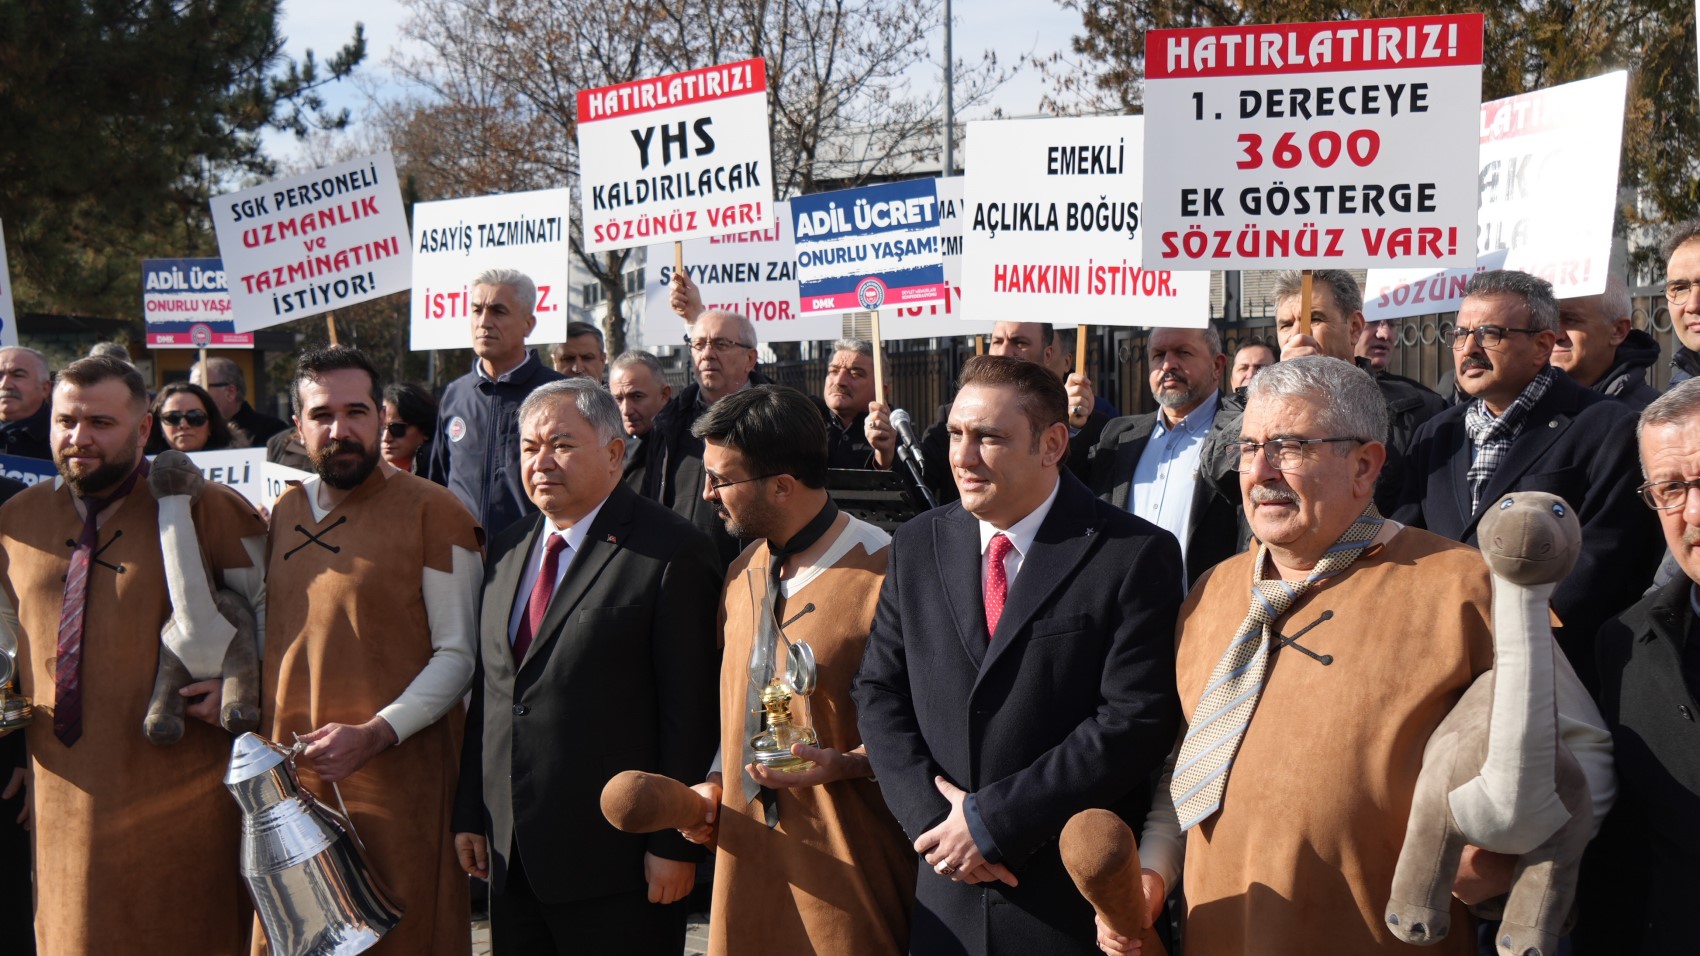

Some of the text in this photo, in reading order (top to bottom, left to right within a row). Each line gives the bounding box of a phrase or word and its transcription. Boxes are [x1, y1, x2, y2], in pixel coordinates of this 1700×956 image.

[1167, 23, 1458, 73] HATIRLATIRIZ!
[588, 65, 752, 119] HATIRLATIRIZ!
[1192, 82, 1428, 120] 1. DERECEYE
[631, 117, 715, 170] YHS
[1047, 137, 1124, 175] EMEKLİ
[1236, 129, 1380, 170] 3600
[231, 162, 378, 222] SGK PERSONELİ
[593, 161, 760, 211] KALDIRILACAK
[1180, 181, 1436, 217] EK GÖSTERGE
[243, 195, 379, 249] UZMANLIK
[419, 214, 561, 256] ASAYİŞ TAZMİNATI
[594, 202, 762, 243] SÖZÜNÜZ VAR!
[797, 202, 852, 237] ADİL
[853, 196, 935, 230] ÜCRET
[973, 195, 1143, 240] AÇLIKLA BOĞUŞ
[304, 236, 326, 252] ve
[798, 236, 938, 267] ONURLU YAŞAM!
[1161, 223, 1457, 259] SÖZÜNÜZ VAR!
[146, 266, 189, 290] ADİL
[241, 236, 399, 295] TAZMİNATINI
[659, 262, 760, 287] SYYANEN
[994, 259, 1177, 297] HAKKINI İSTİYOR.
[147, 300, 198, 312] ONURLU
[273, 271, 376, 315] İSTİYOR!
[813, 298, 834, 309] DMK
